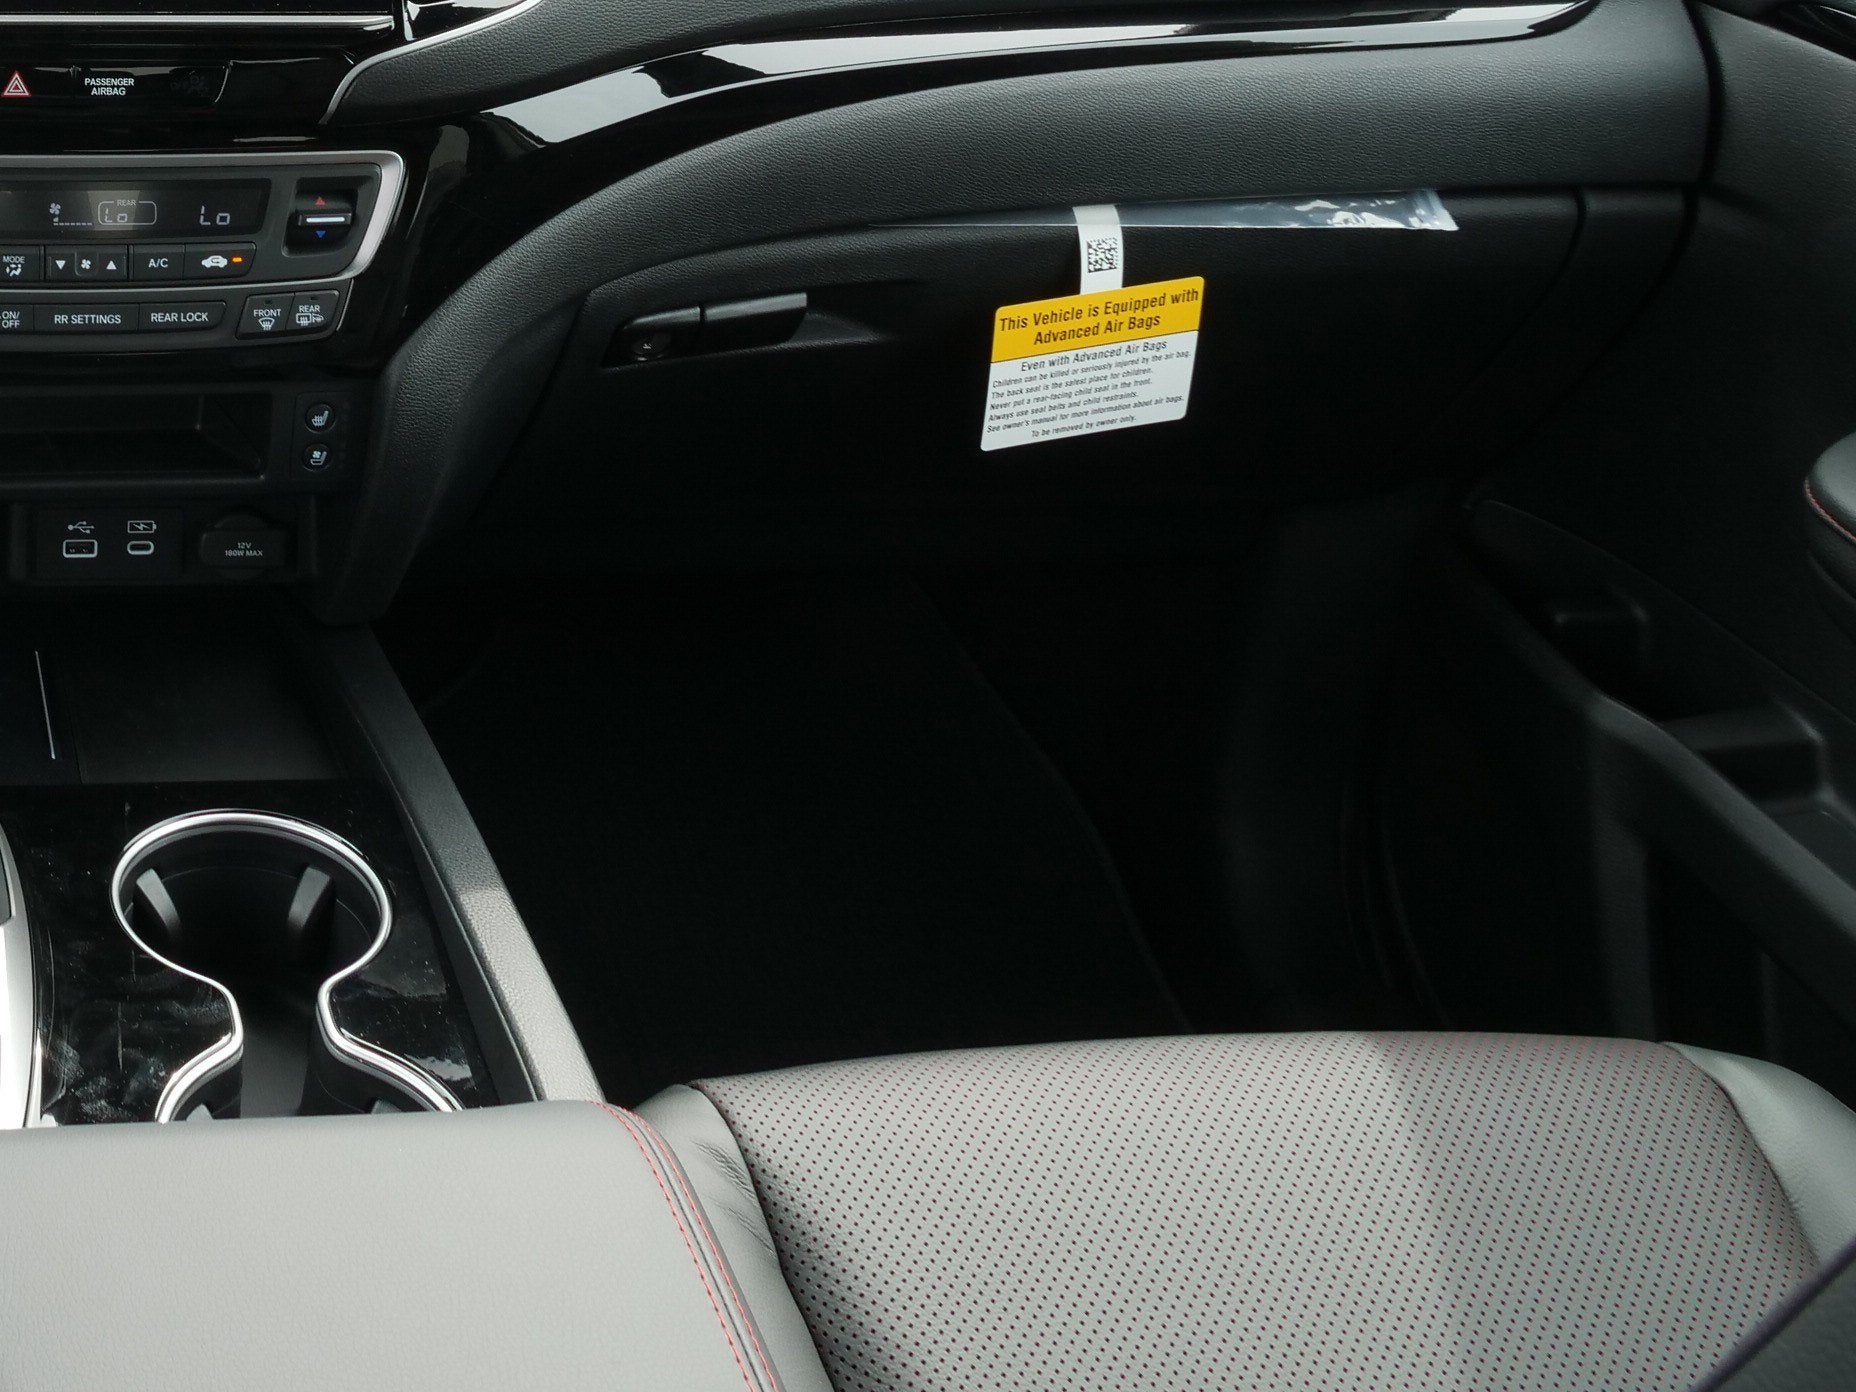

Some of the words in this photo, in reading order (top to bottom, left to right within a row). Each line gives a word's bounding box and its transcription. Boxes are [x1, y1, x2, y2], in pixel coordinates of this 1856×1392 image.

[85, 78, 135, 86] PASSENGER
[91, 87, 126, 96] AIRBAG
[148, 259, 168, 268] A/C
[254, 309, 281, 318] FRONT
[1000, 318, 1027, 331] This
[1033, 309, 1082, 326] Vehicle
[1088, 305, 1099, 317] is
[1105, 293, 1166, 315] Equipped
[1171, 289, 1198, 303] with
[2, 311, 20, 320] ON/
[54, 315, 70, 324] RR
[71, 314, 121, 324] SETTINGS
[151, 313, 178, 322] REAR
[181, 312, 208, 322] LOCK
[2, 320, 20, 328] OFF
[1034, 323, 1099, 345] Advanced
[1105, 321, 1123, 333] Air
[1129, 315, 1161, 330] Bags
[1021, 361, 1045, 371] Even
[1049, 356, 1069, 367] with
[1073, 349, 1121, 363] Advanced
[1125, 344, 1139, 354] Air
[1143, 341, 1167, 353] Bags
[993, 376, 1022, 388] Children
[1025, 375, 1039, 383] can
[1041, 371, 1048, 380] be
[1081, 362, 1112, 373] seriously
[1152, 354, 1162, 362] the
[991, 390, 1004, 398] The
[1007, 387, 1023, 396] back
[1025, 384, 1041, 393] seat
[1052, 380, 1063, 389] the
[1065, 376, 1086, 387] safest
[1089, 374, 1108, 384] place
